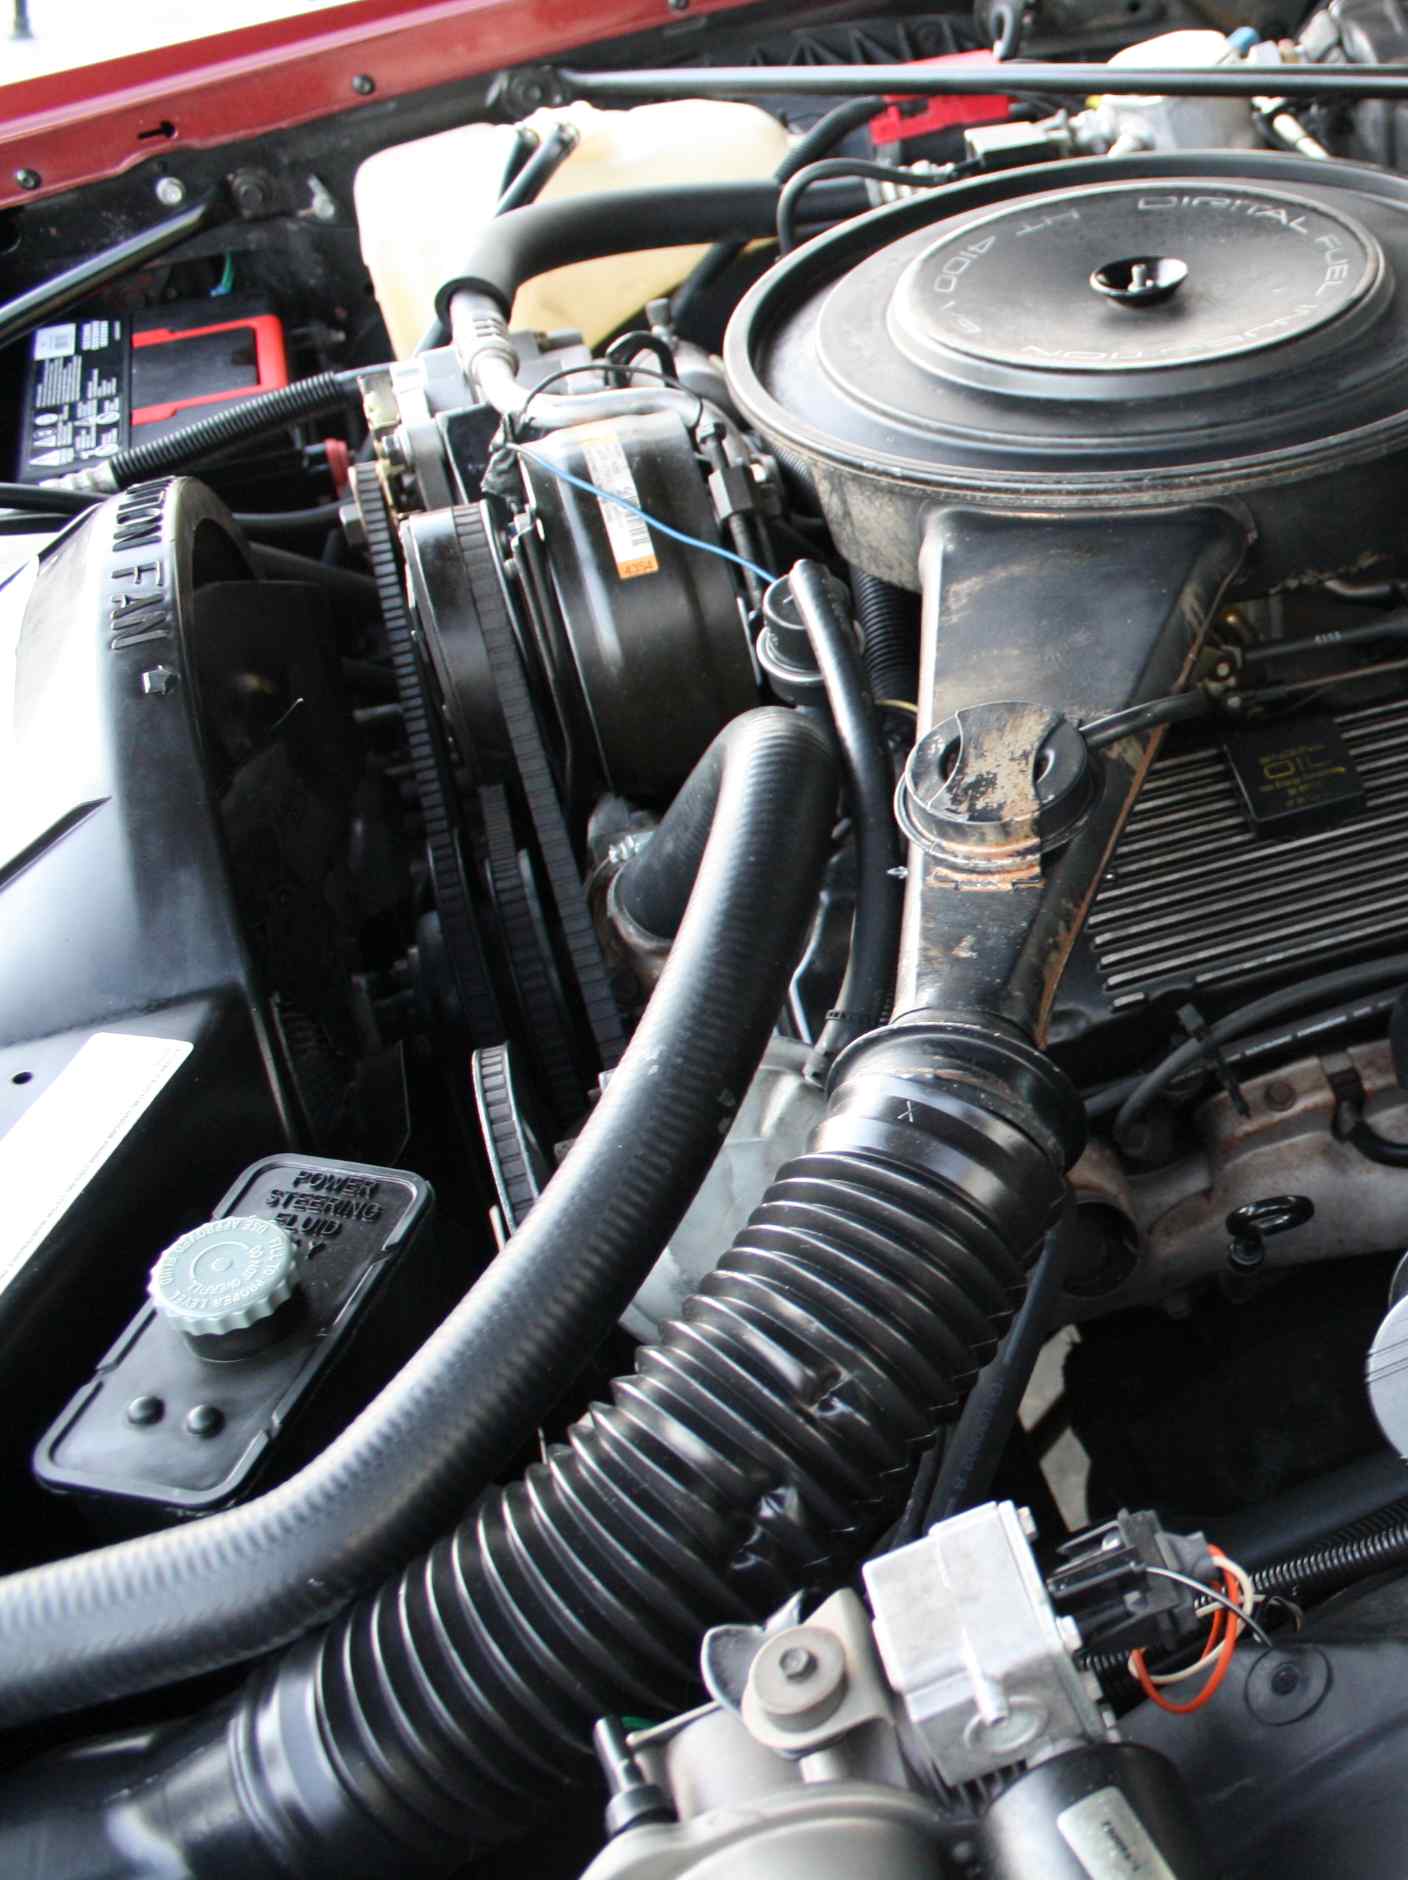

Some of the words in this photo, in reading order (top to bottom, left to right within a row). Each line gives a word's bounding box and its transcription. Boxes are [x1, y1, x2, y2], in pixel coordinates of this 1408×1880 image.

[1015, 207, 1082, 237] HT
[1137, 194, 1309, 235] DIGITAL
[1315, 234, 1351, 296] FUEL
[933, 234, 997, 294] 4100
[111, 559, 169, 651] FAN
[292, 1170, 380, 1199] POWER
[265, 1188, 384, 1223] STEERING
[274, 1212, 343, 1238] FLUID
